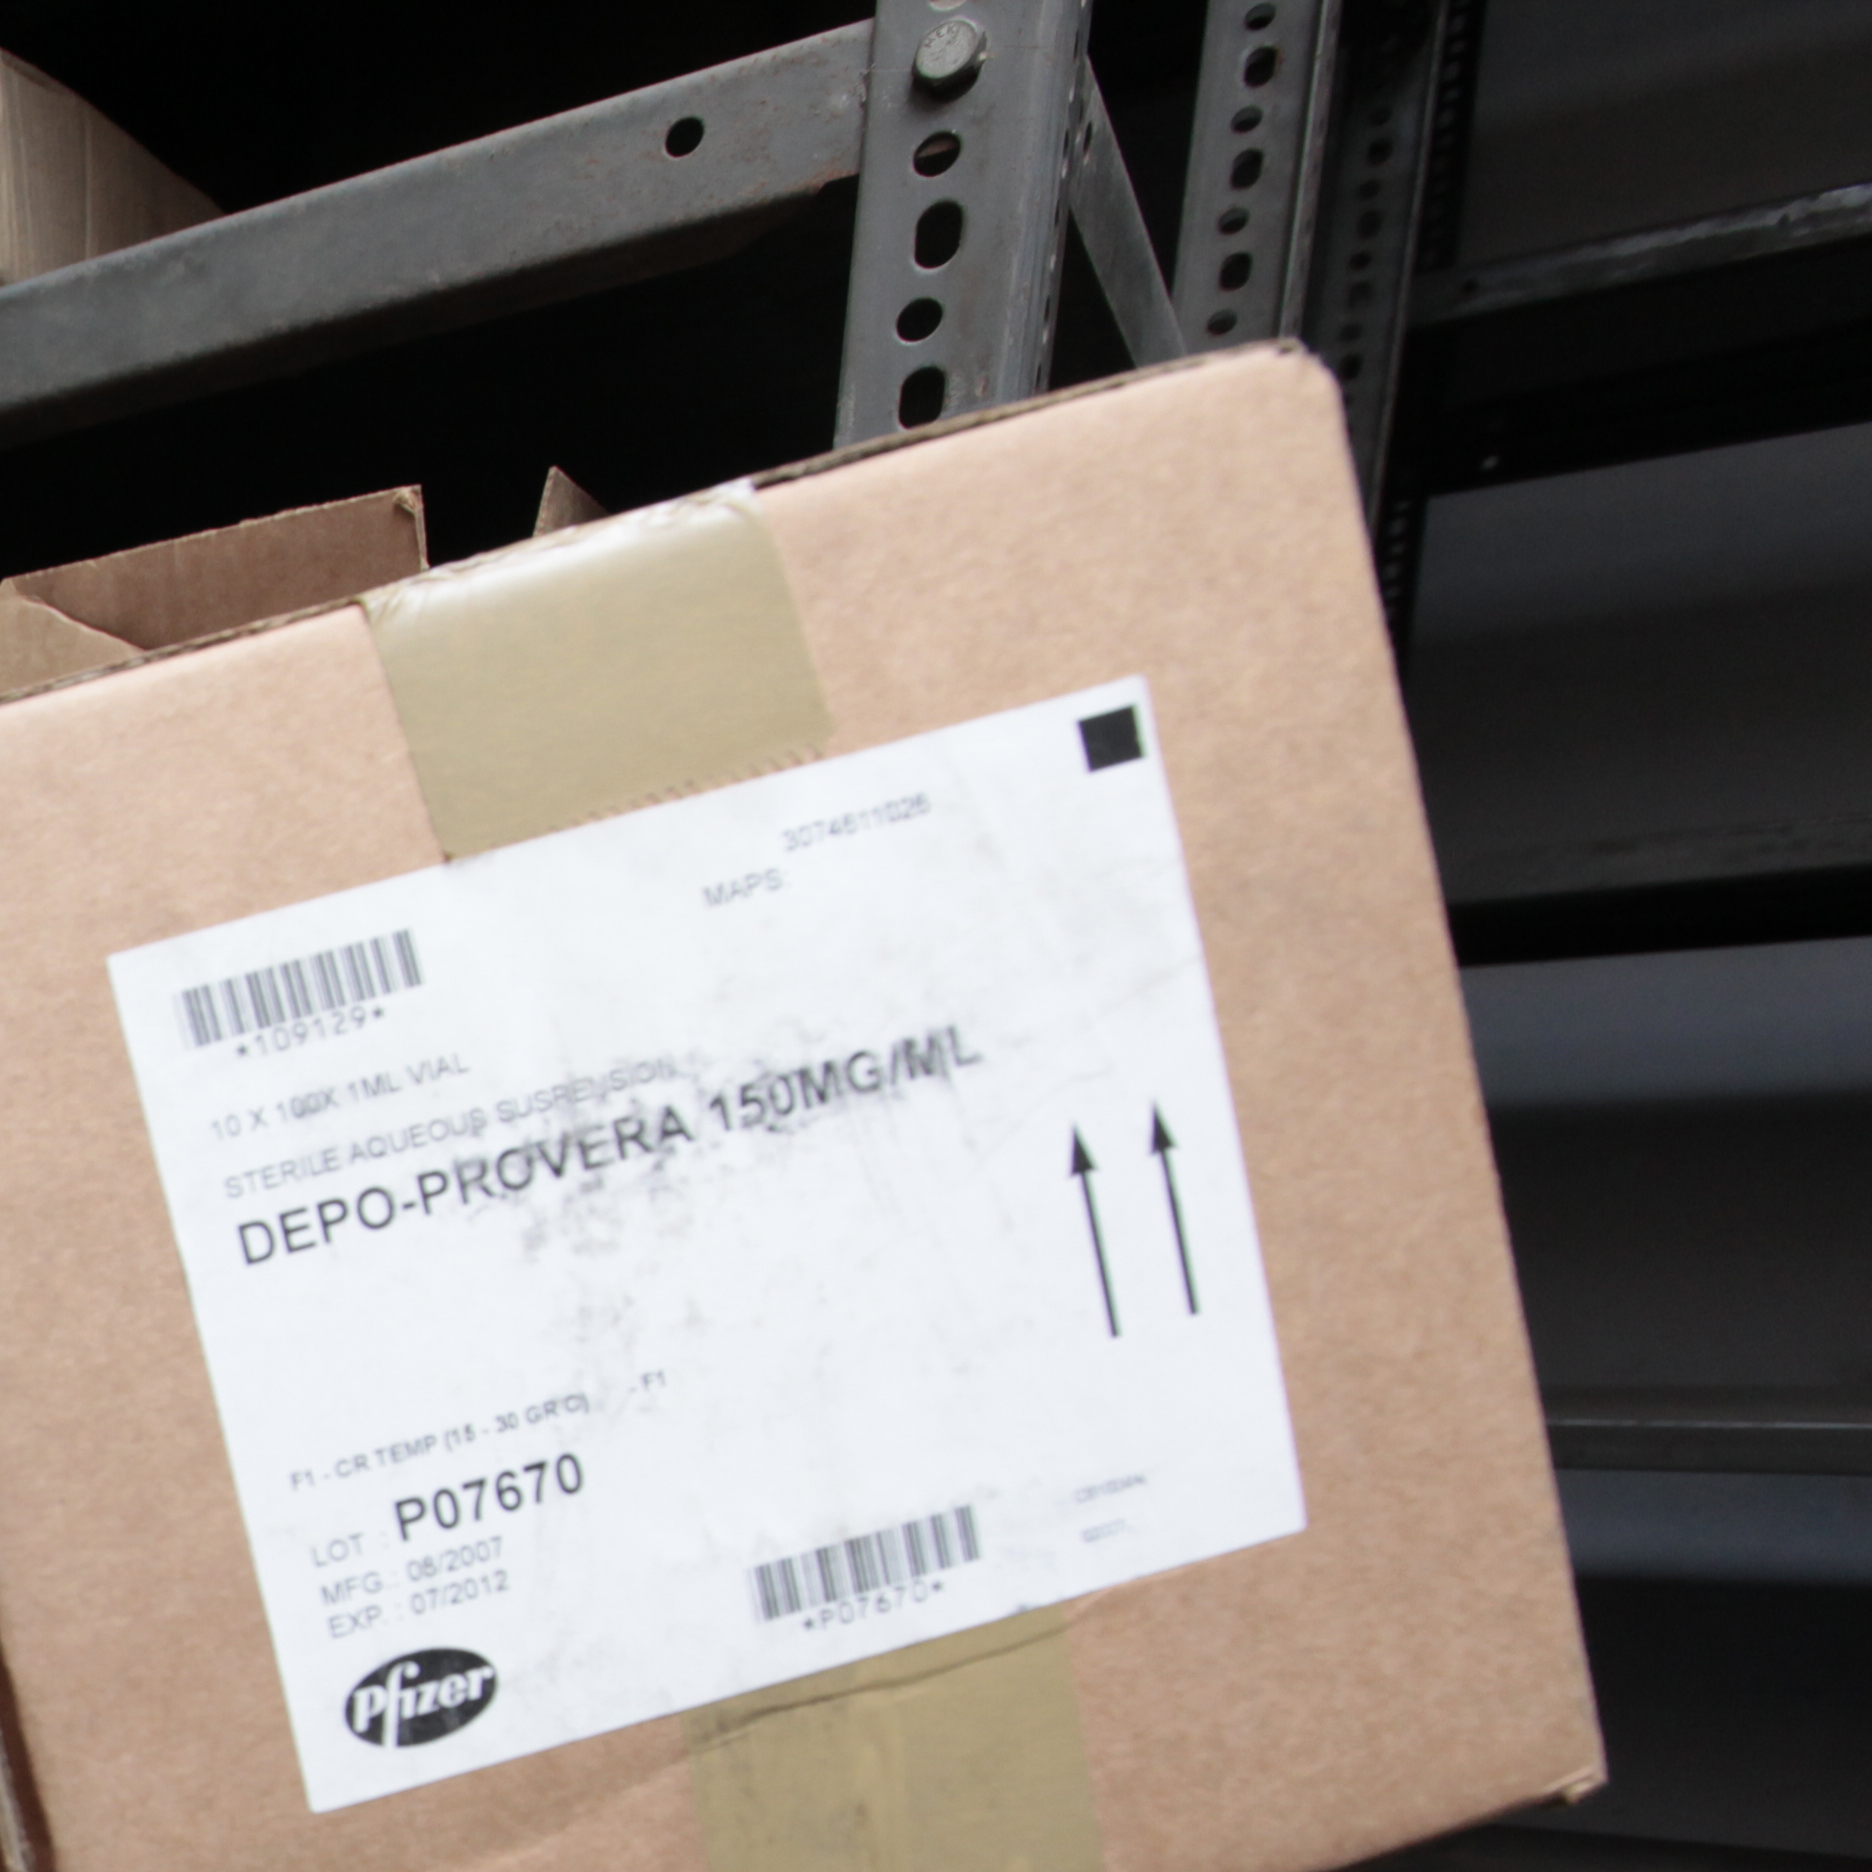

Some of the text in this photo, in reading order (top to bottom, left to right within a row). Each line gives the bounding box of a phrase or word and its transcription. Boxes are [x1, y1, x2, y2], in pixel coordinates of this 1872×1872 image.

[210, 1114, 243, 1142] 10
[245, 1106, 270, 1132] X
[347, 1070, 402, 1104] 1ML
[404, 1051, 470, 1088] VIAL
[222, 1053, 679, 1200] STERILE AQUEOUS SUSPENSION
[233, 1019, 983, 1267] DEPO-PROVERA 150MG/ML
[288, 1467, 317, 1492] F1
[332, 1452, 371, 1479] CR
[374, 1433, 439, 1467] TEMP
[493, 1410, 521, 1434] 30
[309, 1532, 366, 1568] LOT
[391, 1450, 588, 1542] P07670
[403, 1534, 507, 1584] 08/2007
[407, 1567, 512, 1616] 07/2012
[348, 1656, 496, 1750] Pfizer
